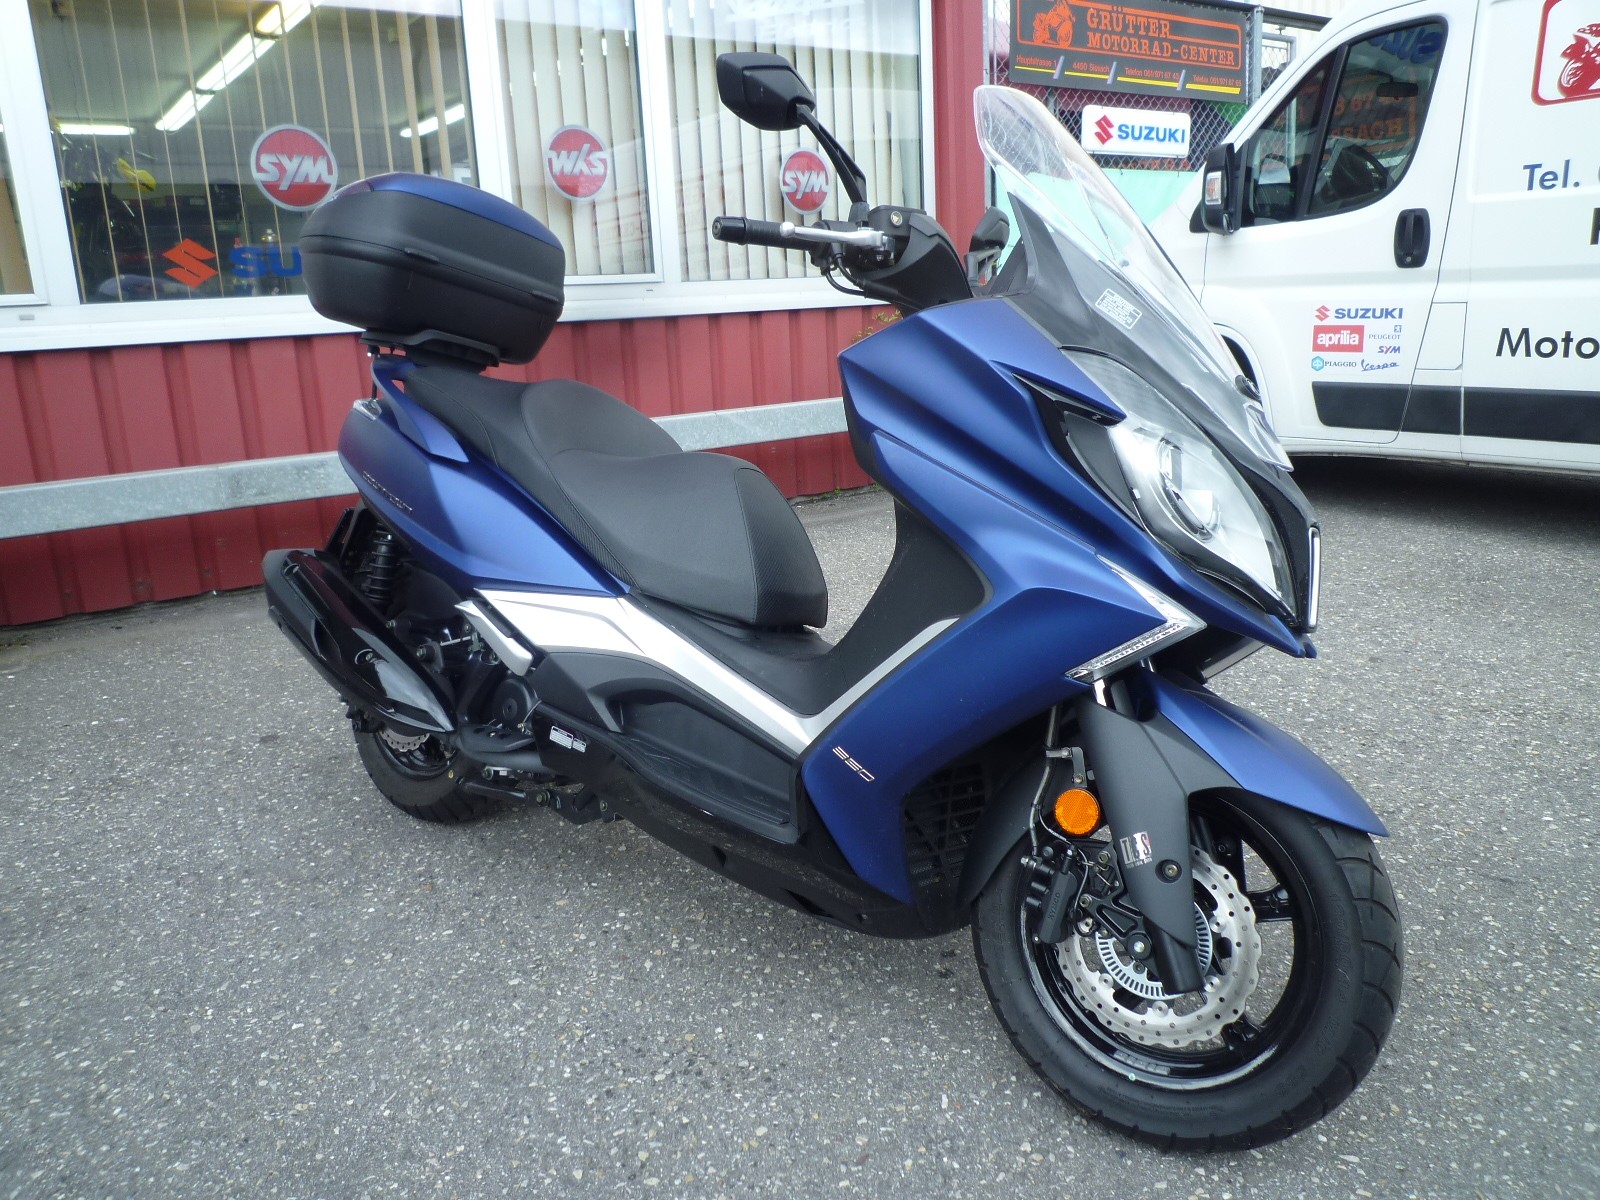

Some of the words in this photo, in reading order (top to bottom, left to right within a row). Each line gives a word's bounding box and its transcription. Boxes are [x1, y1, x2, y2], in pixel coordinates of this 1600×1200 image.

[1087, 7, 1171, 39] GRÜTTER
[1087, 32, 1236, 66] MOTORRAD-CENTER
[1125, 67, 1143, 77] Telefon
[1117, 123, 1186, 143] SUZUKI
[257, 153, 333, 191] SYM
[1522, 159, 1580, 191] Tel.
[782, 170, 829, 199] SYM
[1334, 307, 1404, 319] SUZUKI
[1317, 330, 1360, 347] aprilia
[1495, 327, 1600, 359] Moto
[1377, 345, 1401, 355] SYM
[1324, 360, 1357, 368] PIAGGIO
[1360, 358, 1400, 372] Vespa
